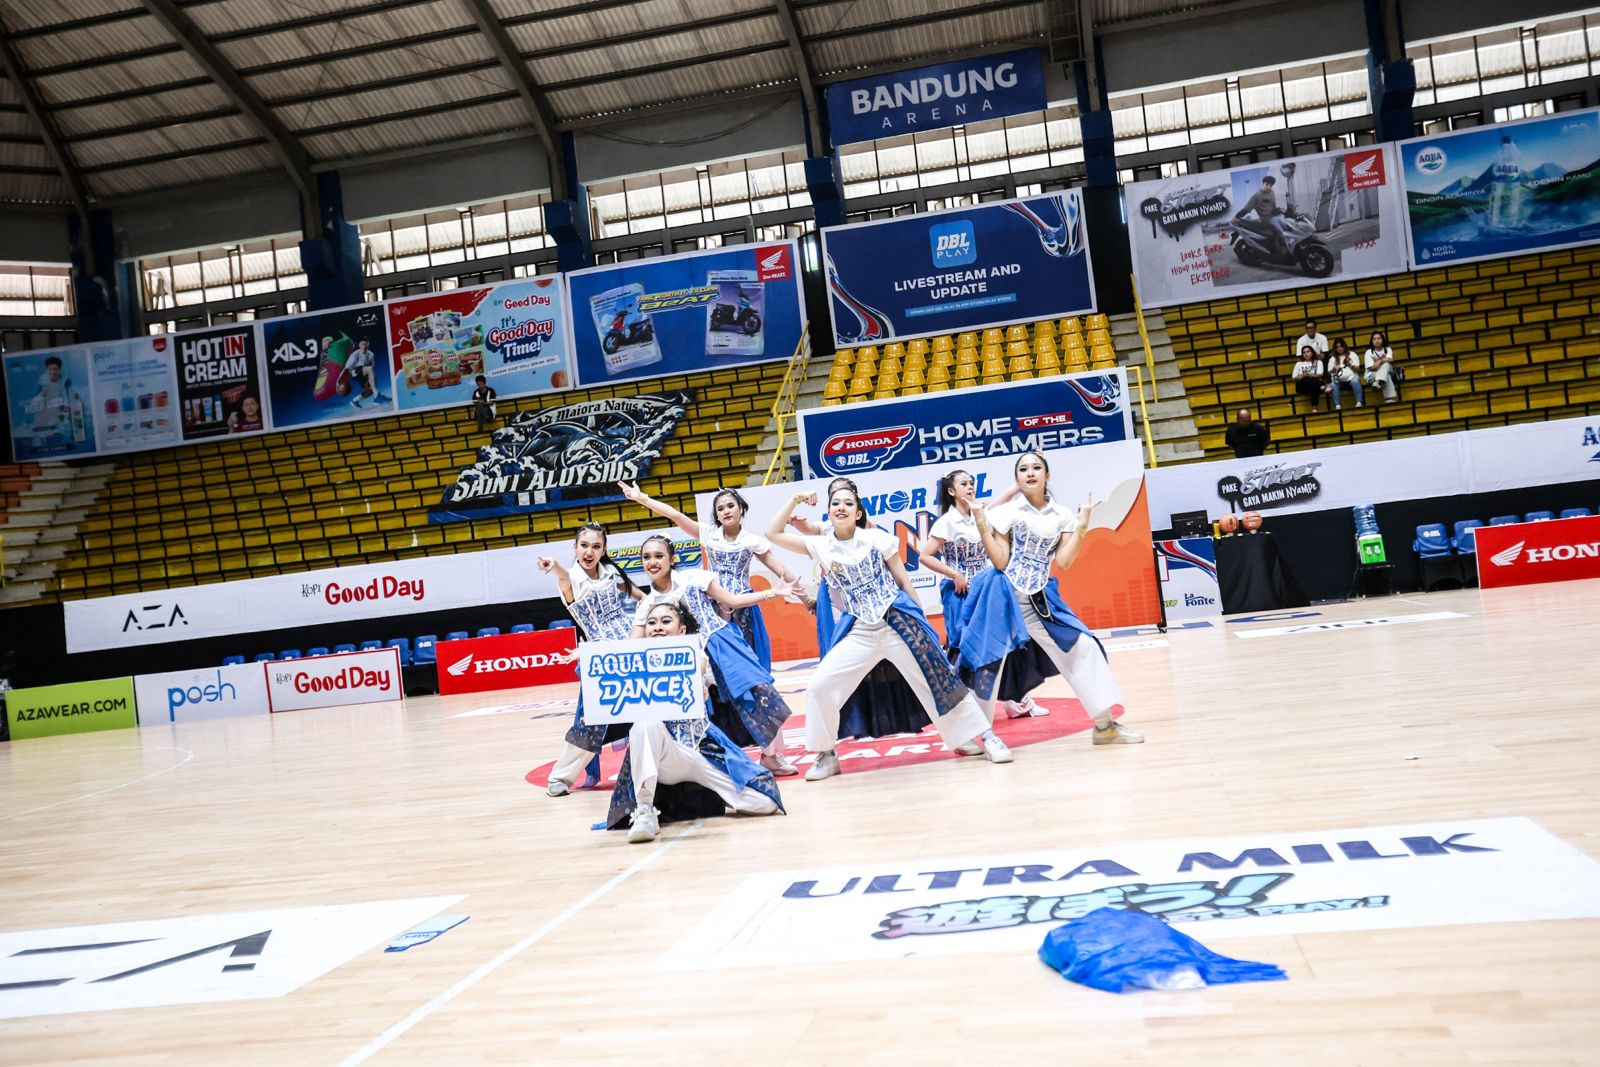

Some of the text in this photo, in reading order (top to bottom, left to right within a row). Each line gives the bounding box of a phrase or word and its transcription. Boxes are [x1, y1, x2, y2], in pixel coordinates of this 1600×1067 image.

[851, 62, 1018, 115] BANDUNG
[882, 98, 992, 129] ARENA
[1419, 152, 1442, 163] AQUA
[1144, 204, 1158, 213] PAKE
[1178, 209, 1198, 220] MAKIN
[936, 232, 970, 251] DBL
[936, 248, 969, 259] PLAY
[894, 263, 1021, 292] LIVESTREAM AND
[930, 282, 987, 299] UPDATE
[504, 297, 529, 309] Good
[531, 295, 550, 306] Day
[490, 320, 553, 345] Good Day
[501, 316, 515, 328] It's
[503, 335, 542, 358] Time!
[185, 357, 247, 383] CREAM
[557, 404, 601, 420] Maiora
[604, 400, 638, 412] Natus
[918, 414, 1066, 444] HOME OF THE
[845, 436, 892, 451] HONDA
[920, 426, 1104, 464] DREAMERS
[847, 453, 870, 466] DBL
[450, 460, 641, 502] SAINT ALOYSIUS
[1222, 483, 1238, 494] PAKE
[1243, 496, 1260, 507] GAYA
[1261, 490, 1285, 502] MAKIN
[325, 579, 378, 605] Good
[382, 575, 425, 601] Day
[910, 576, 933, 584] DANCER
[1185, 597, 1215, 607] Fonte
[474, 653, 562, 674] HONDA
[590, 652, 693, 677] AQUA DBL
[294, 668, 347, 694] Good
[350, 666, 391, 691] Day
[167, 669, 236, 722] posh
[16, 697, 127, 722] AZAWEAR.COM
[782, 833, 1504, 899] ULTRA MILK
